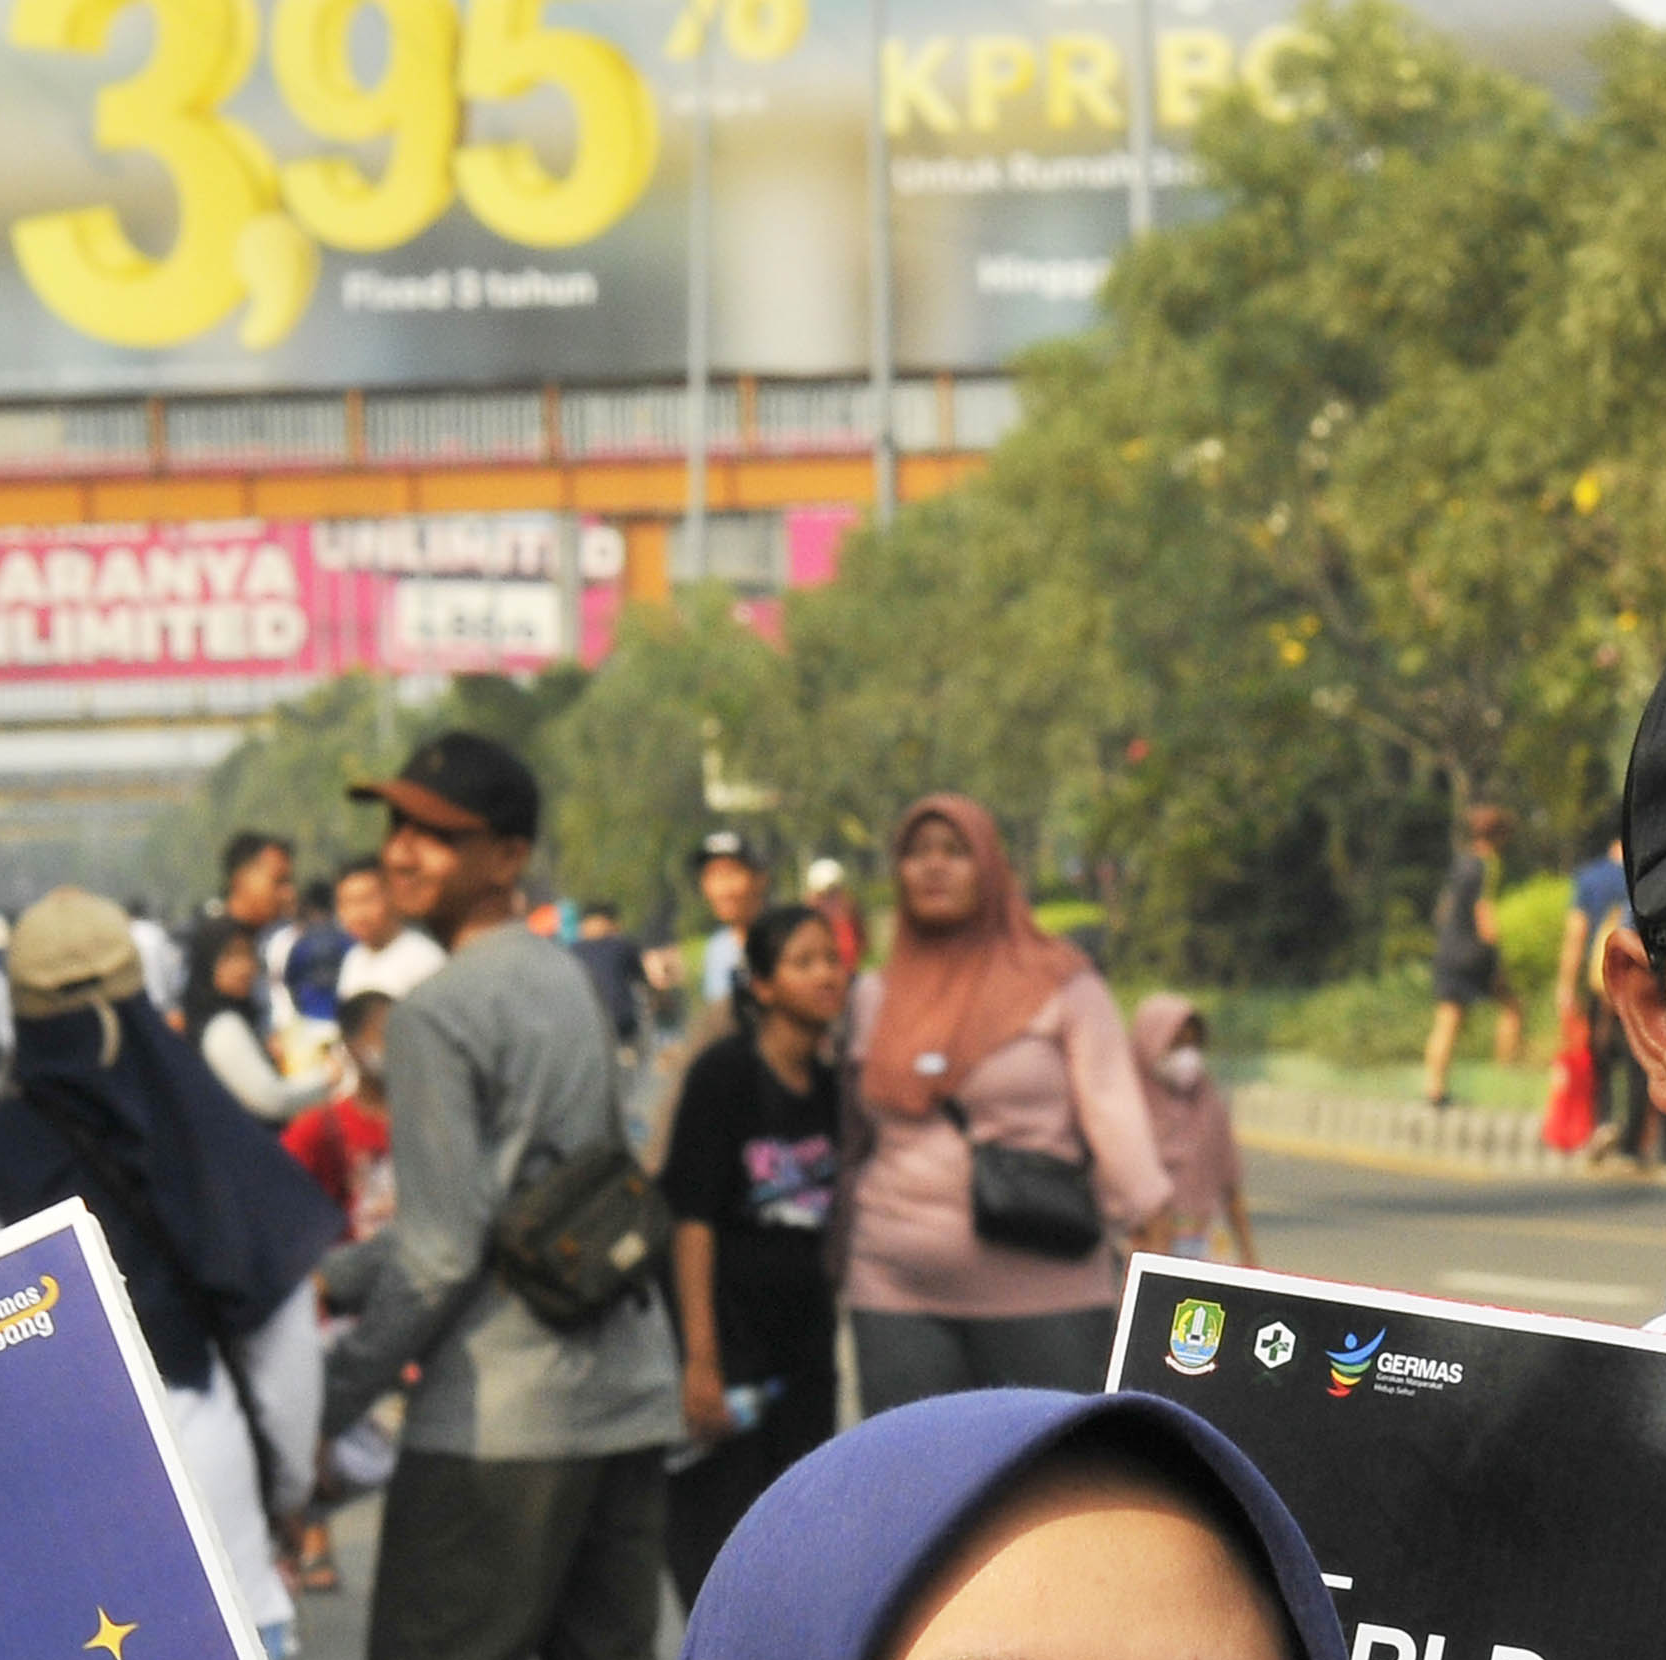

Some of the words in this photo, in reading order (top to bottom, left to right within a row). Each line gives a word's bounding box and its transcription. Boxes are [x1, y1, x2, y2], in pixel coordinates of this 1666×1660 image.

[880, 33, 1124, 136] KPR
[313, 518, 626, 579] UNLIMITD
[1376, 1351, 1464, 1384] GERMAS
